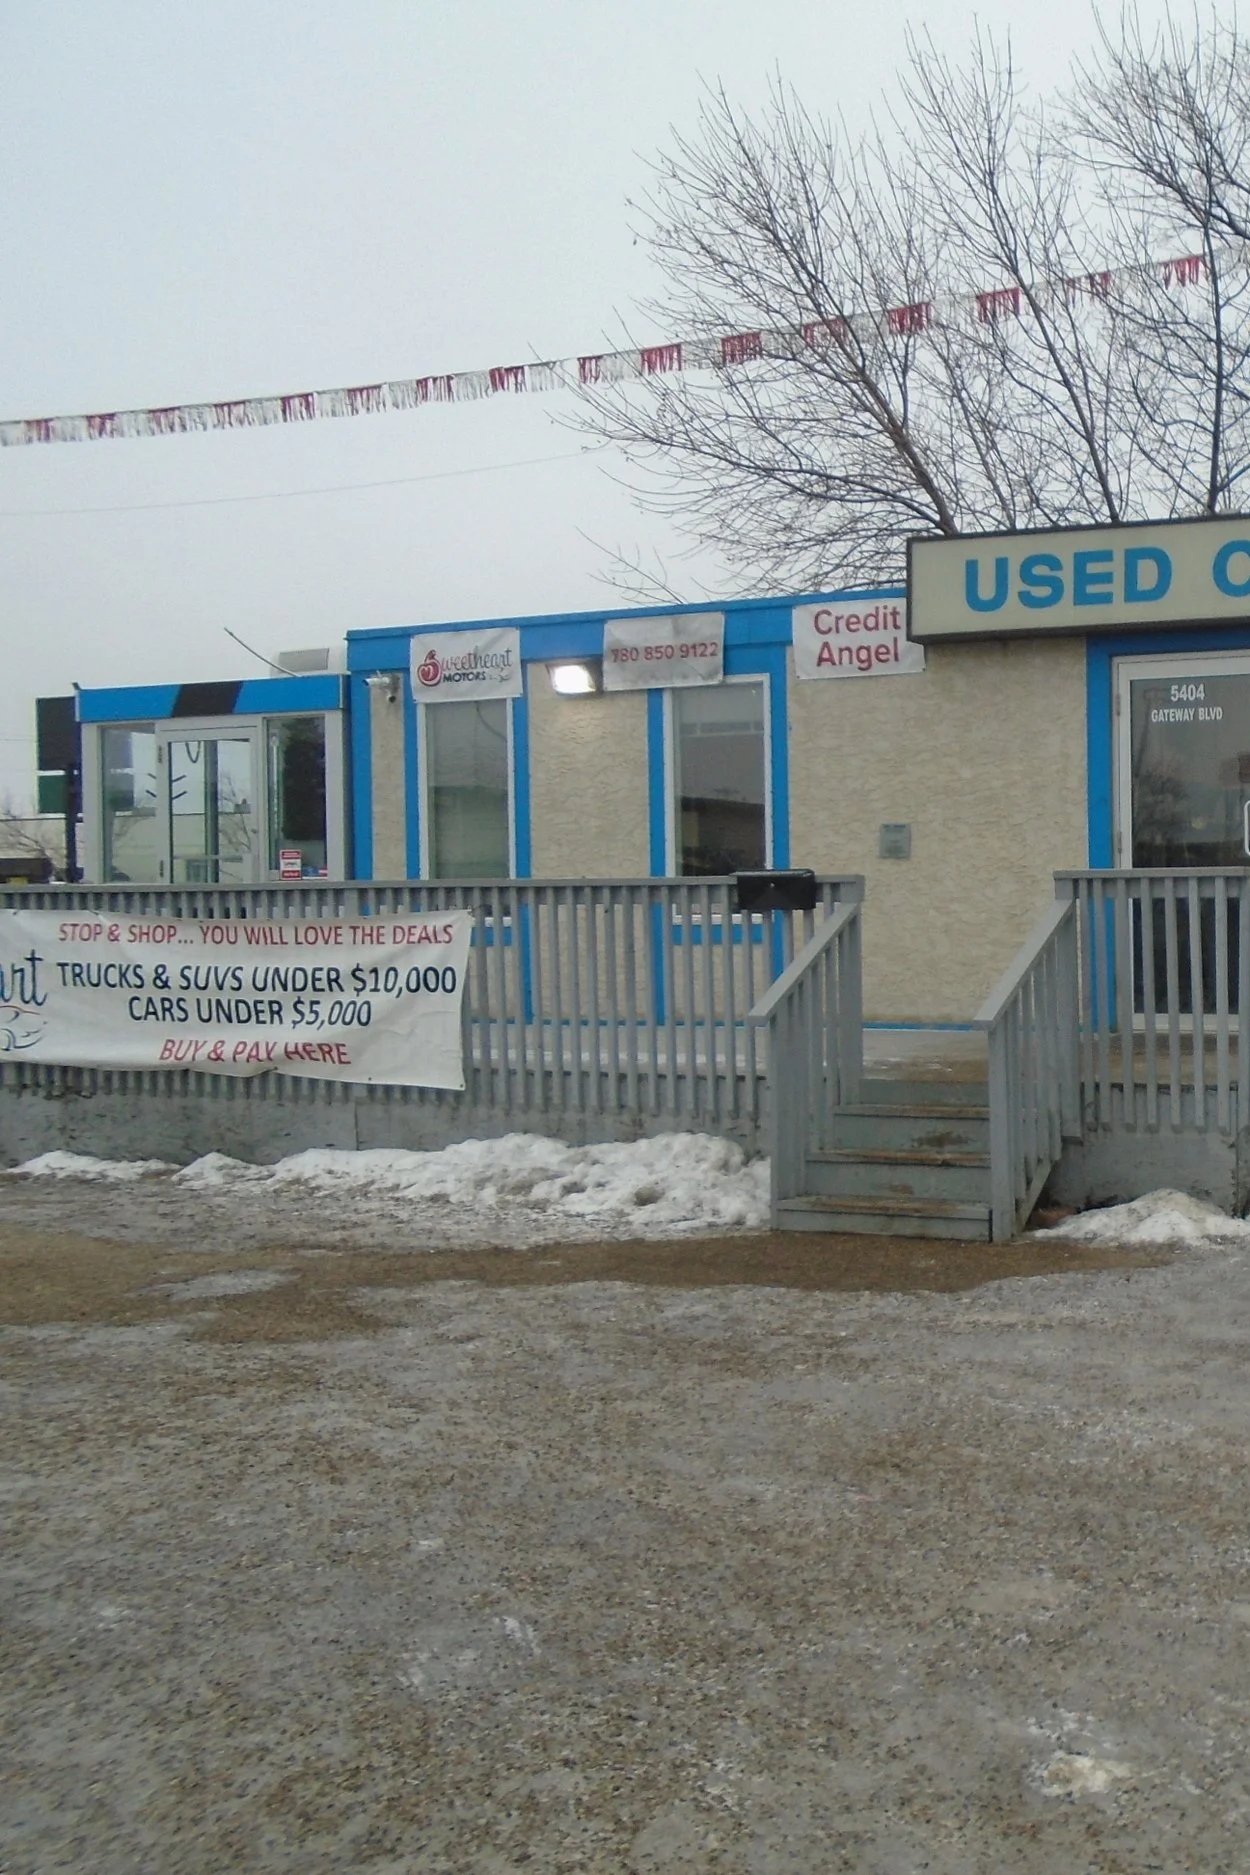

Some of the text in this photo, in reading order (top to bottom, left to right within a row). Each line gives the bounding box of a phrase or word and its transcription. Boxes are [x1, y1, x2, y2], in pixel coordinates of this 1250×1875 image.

[964, 546, 1172, 613] USED
[814, 605, 901, 635] Credit
[611, 642, 718, 663] 780 850 9122
[816, 636, 899, 671] Angel
[442, 671, 486, 683] MOTORS
[1170, 684, 1205, 702] 5404
[1151, 707, 1223, 723] GATEWAY BLVD
[58, 923, 454, 946] STOP & SHOP... YOU WILL LOVE THE DEALS
[0, 949, 48, 1006] rt
[56, 962, 457, 998] TRUCKS & SUVS UNDER $10,000
[128, 995, 372, 1031] CARS UNDER $5,000
[159, 1038, 352, 1065] BUY & PAY HERE
